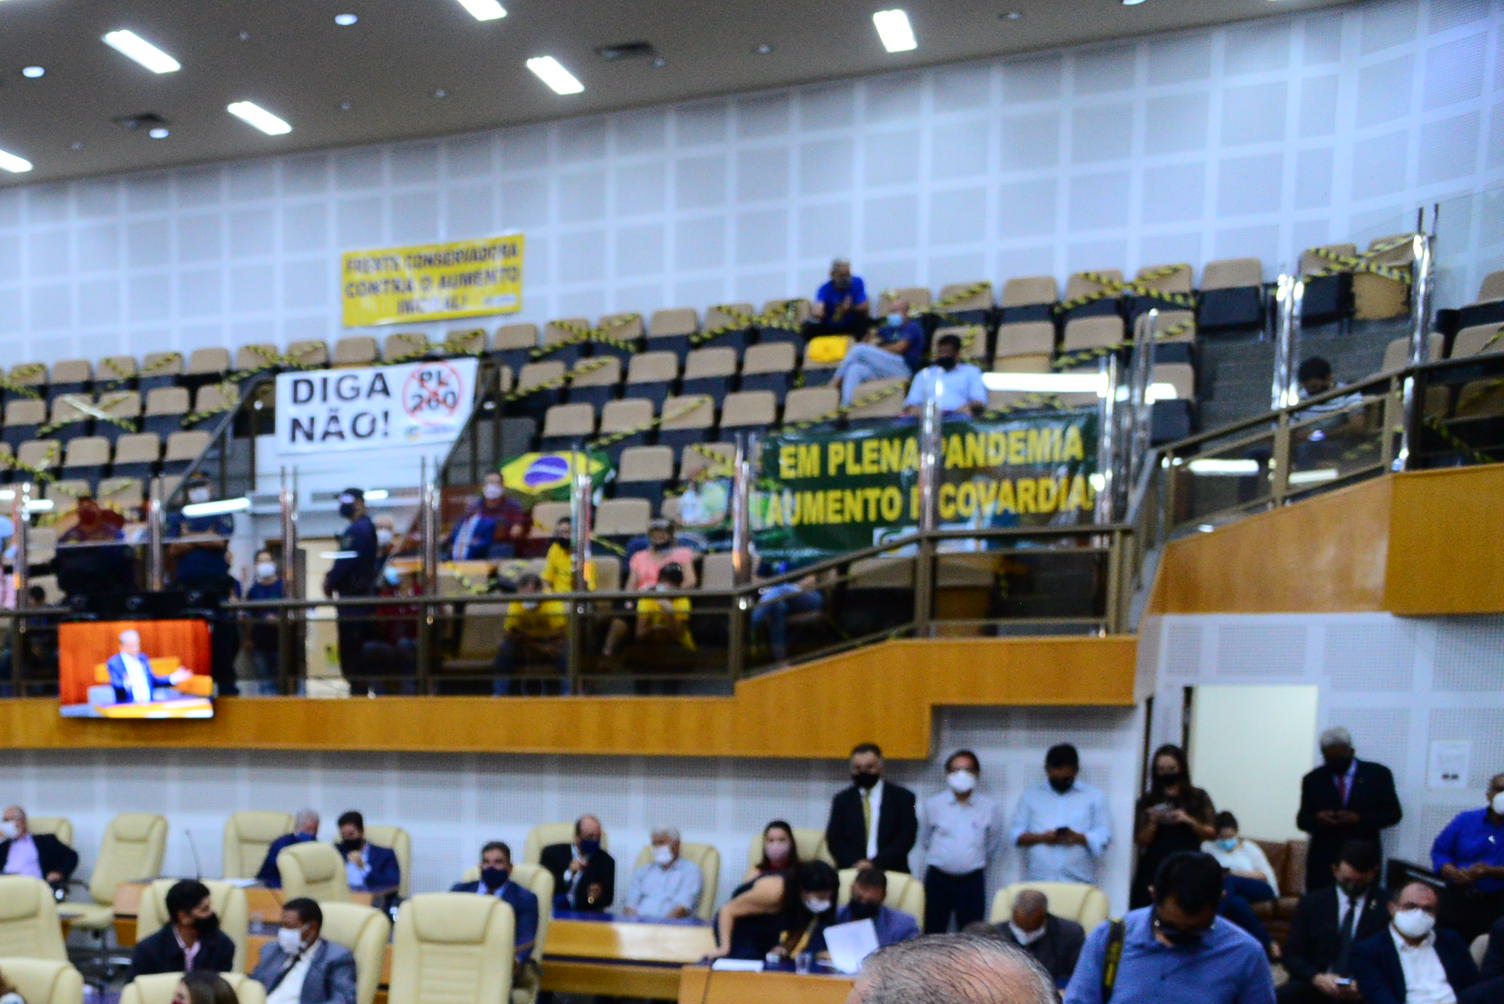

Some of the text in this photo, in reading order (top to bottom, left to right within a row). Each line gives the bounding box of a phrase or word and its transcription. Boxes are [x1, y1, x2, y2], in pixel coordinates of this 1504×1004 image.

[345, 277, 413, 298] CONTRA
[438, 266, 519, 289] AUMENTO
[292, 372, 391, 404] DIGA
[420, 370, 449, 387] PL
[289, 408, 389, 442] NÃO!
[780, 424, 1084, 479] EM PLENA ANDEMIA
[765, 485, 903, 526] AUMENTO
